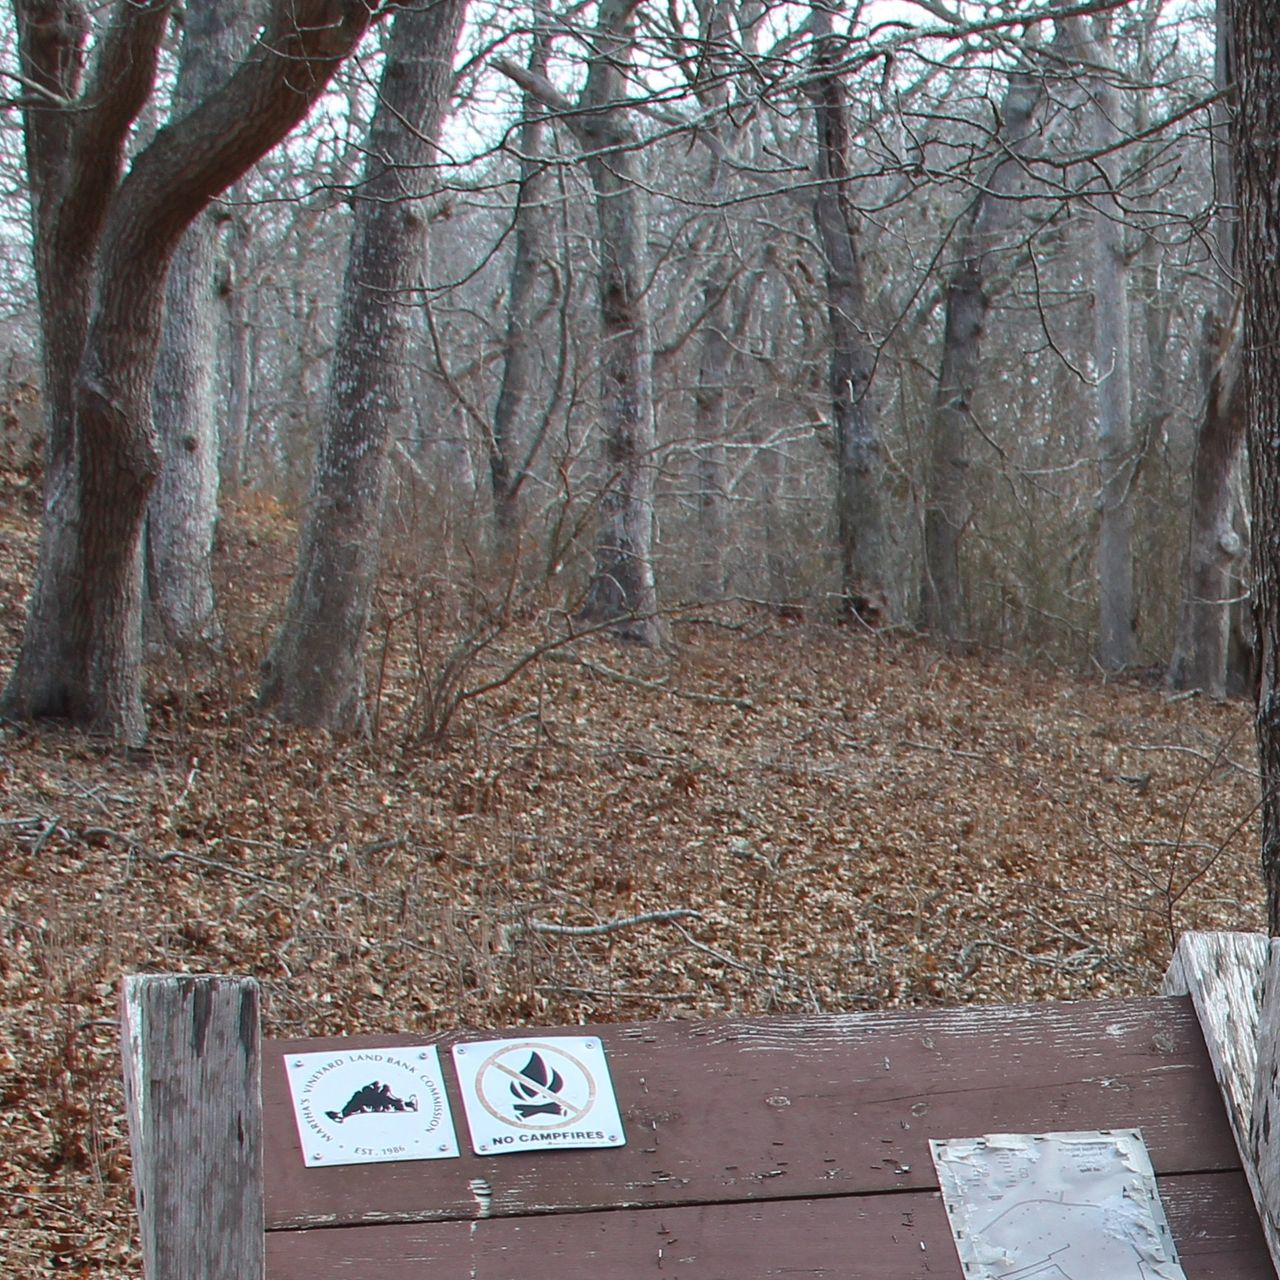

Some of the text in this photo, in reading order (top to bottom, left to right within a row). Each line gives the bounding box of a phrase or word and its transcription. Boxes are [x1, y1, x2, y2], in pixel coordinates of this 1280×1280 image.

[301, 1054, 443, 1142] MARTHA'S VINEYARD LAND BANK COMMISSION
[492, 1131, 605, 1146] NO CAMPFIRES
[353, 1145, 406, 1156] EST. 1986
